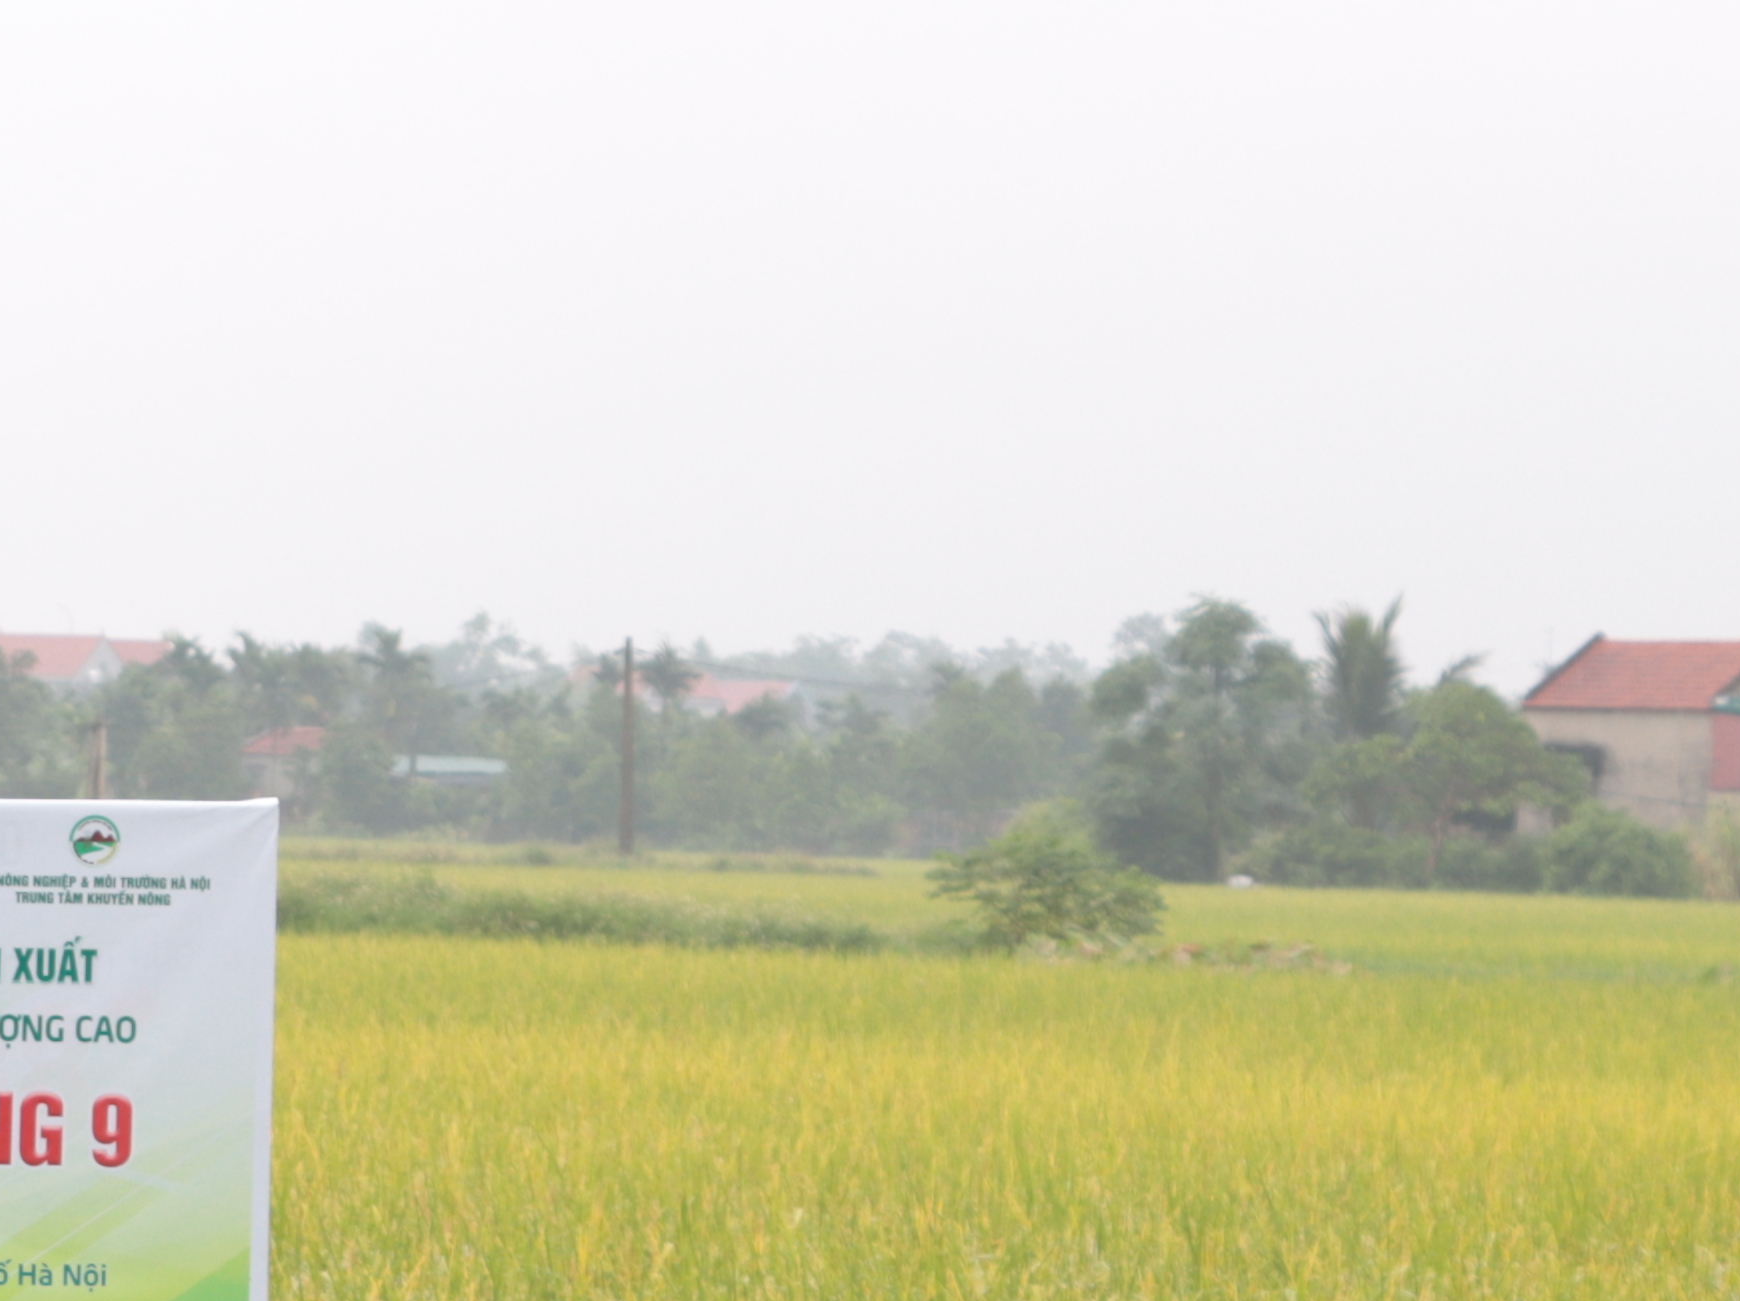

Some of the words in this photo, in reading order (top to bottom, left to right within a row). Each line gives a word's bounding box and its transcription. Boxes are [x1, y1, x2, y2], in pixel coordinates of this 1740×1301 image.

[33, 874, 77, 890] NGHIỆP
[81, 876, 89, 888] &
[94, 875, 116, 888] MÔI
[171, 876, 186, 889] HÀ
[190, 876, 210, 891] NỘI
[16, 892, 53, 903] TRUNG
[59, 891, 83, 903] TÂM
[87, 890, 134, 905] KHUYẾN
[138, 892, 170, 905] NÔNG
[13, 937, 97, 983] XUẤT
[76, 1016, 136, 1043] CAO
[91, 1094, 132, 1168] 9
[18, 1264, 52, 1286] Hà
[64, 1264, 106, 1291] Nội
